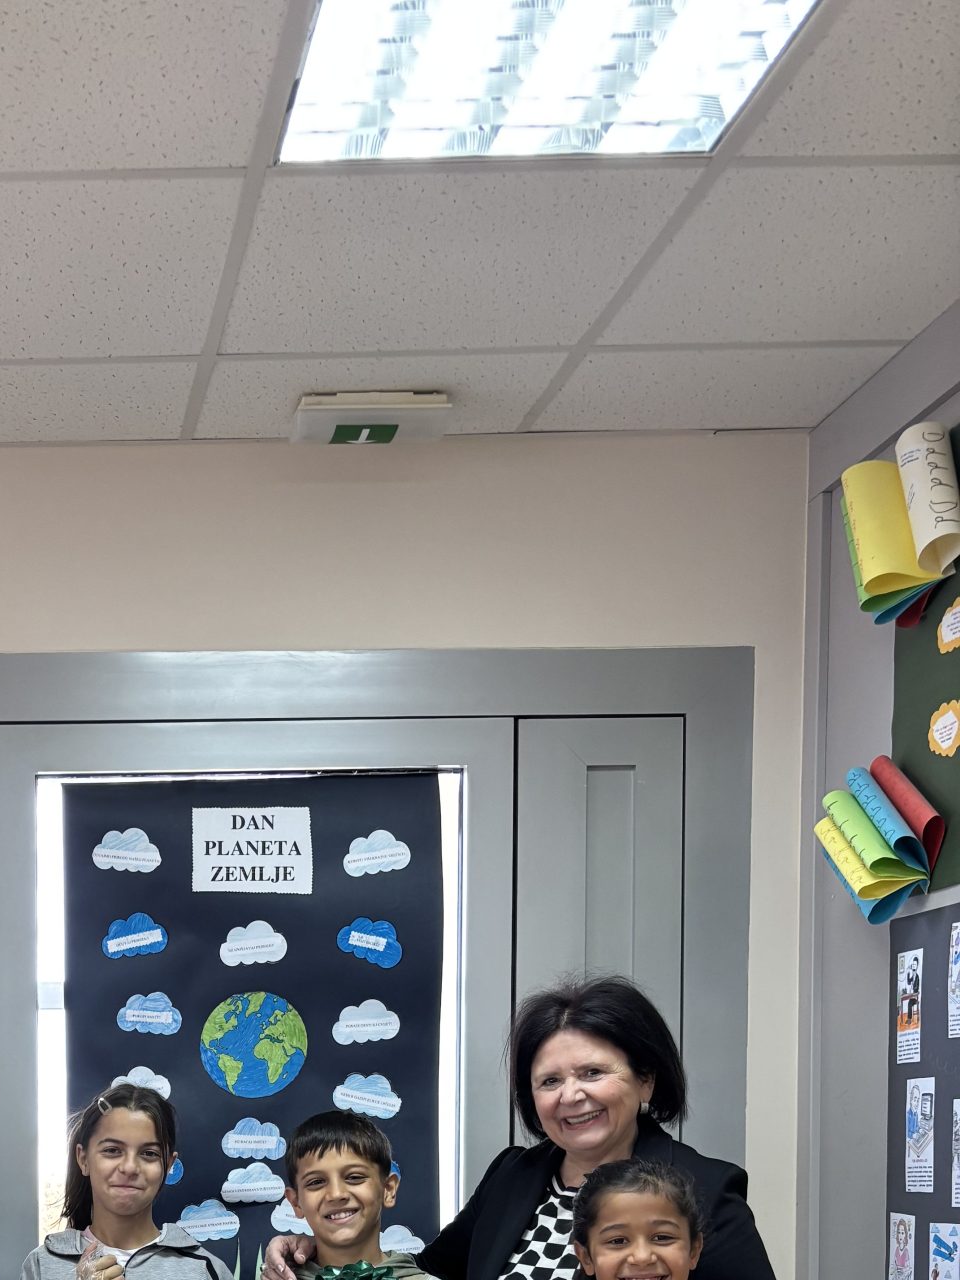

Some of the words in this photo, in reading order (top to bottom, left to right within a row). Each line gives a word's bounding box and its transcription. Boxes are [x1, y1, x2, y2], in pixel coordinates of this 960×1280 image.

[231, 814, 275, 830] DAN
[204, 840, 302, 856] PLANETA
[211, 866, 295, 883] ZEMLJE
